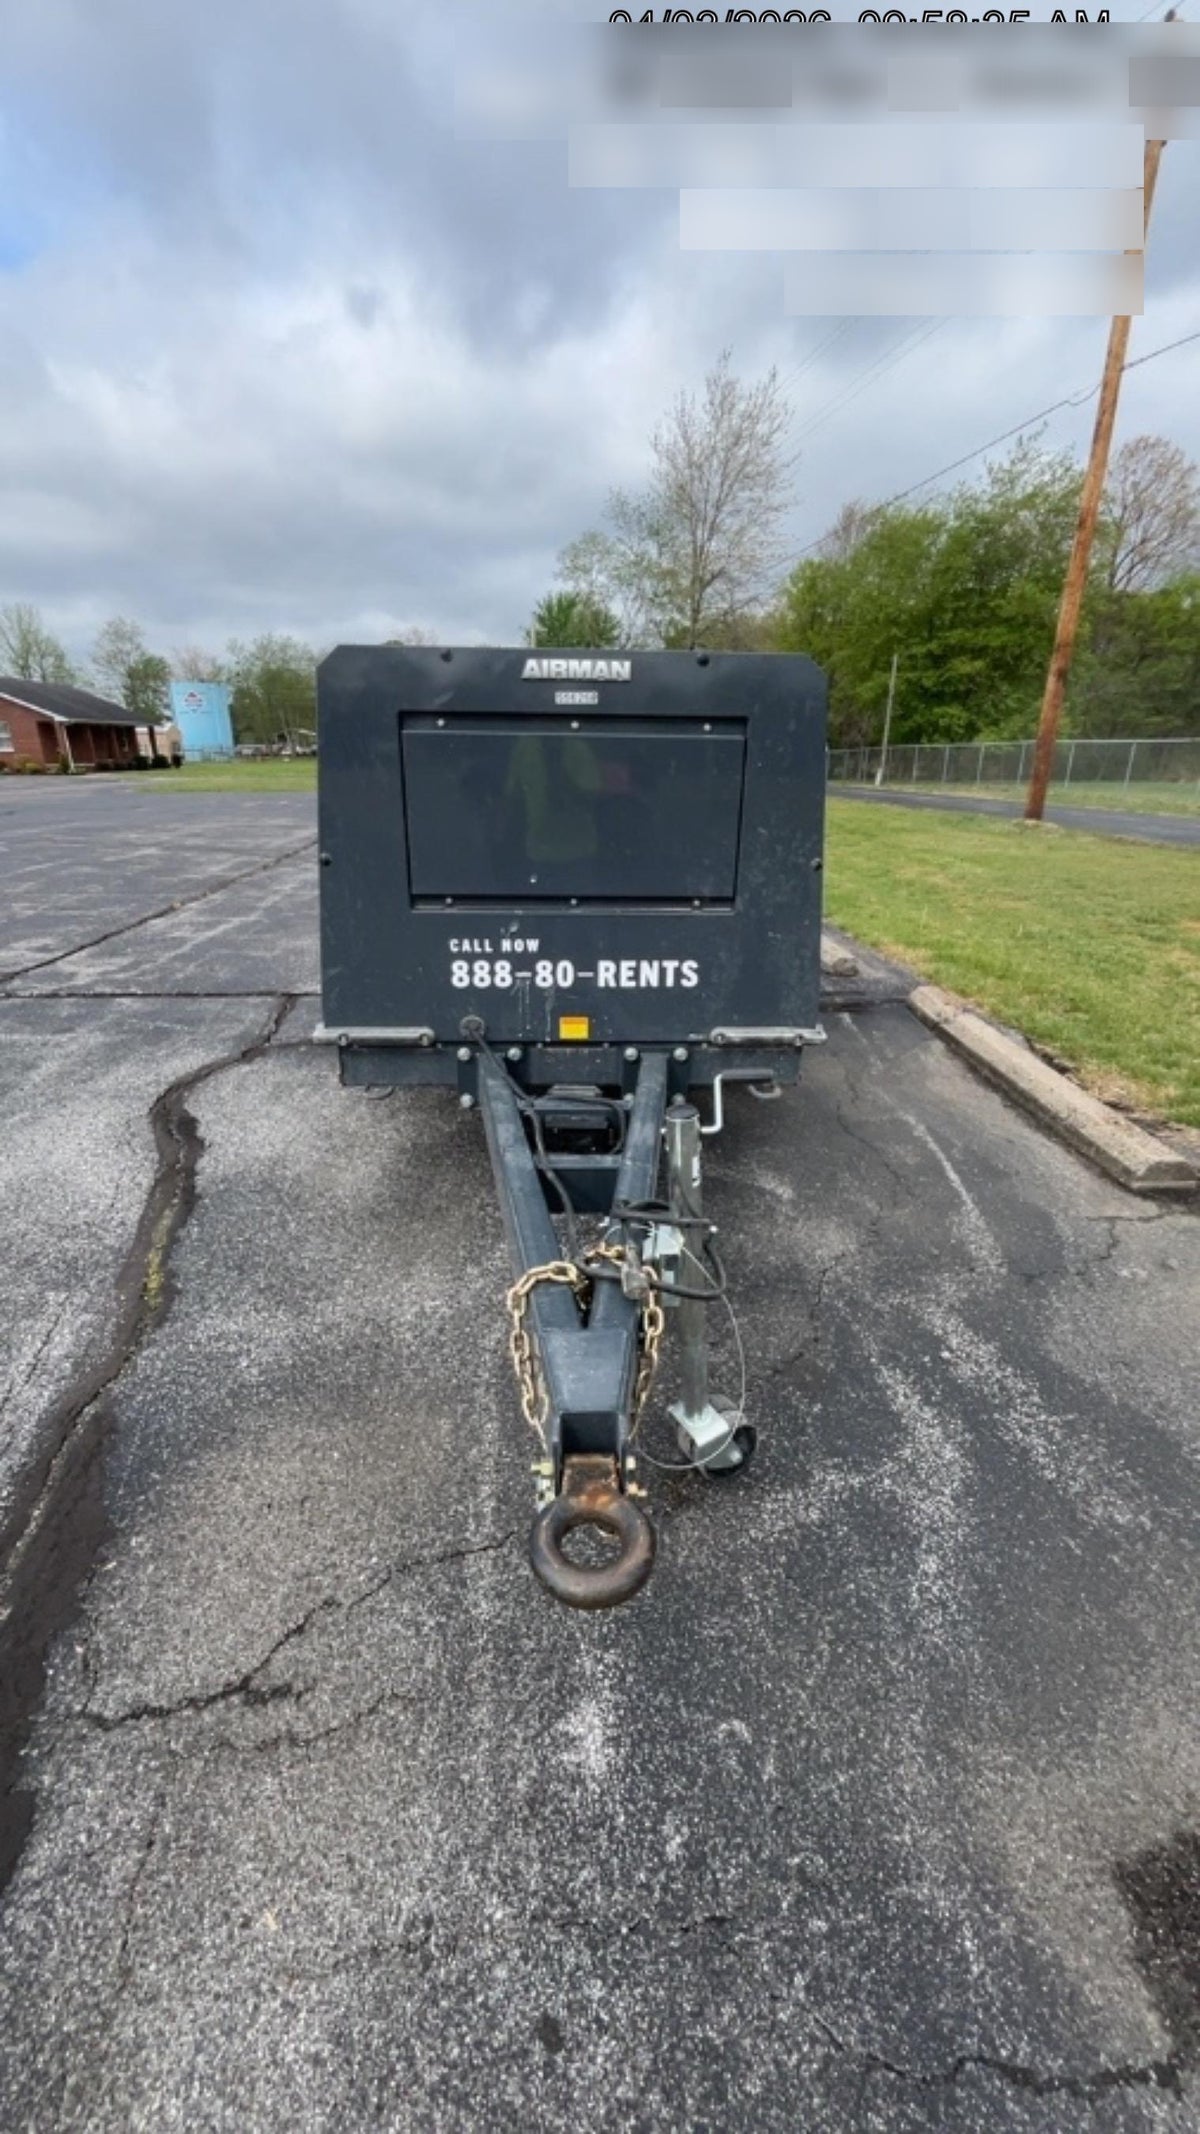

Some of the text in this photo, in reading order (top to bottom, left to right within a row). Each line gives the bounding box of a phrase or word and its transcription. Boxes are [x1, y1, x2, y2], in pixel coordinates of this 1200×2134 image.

[521, 658, 632, 682] AIRMAN
[449, 938, 541, 953] CALL NOW
[450, 959, 700, 989] 888-80-RENTS
